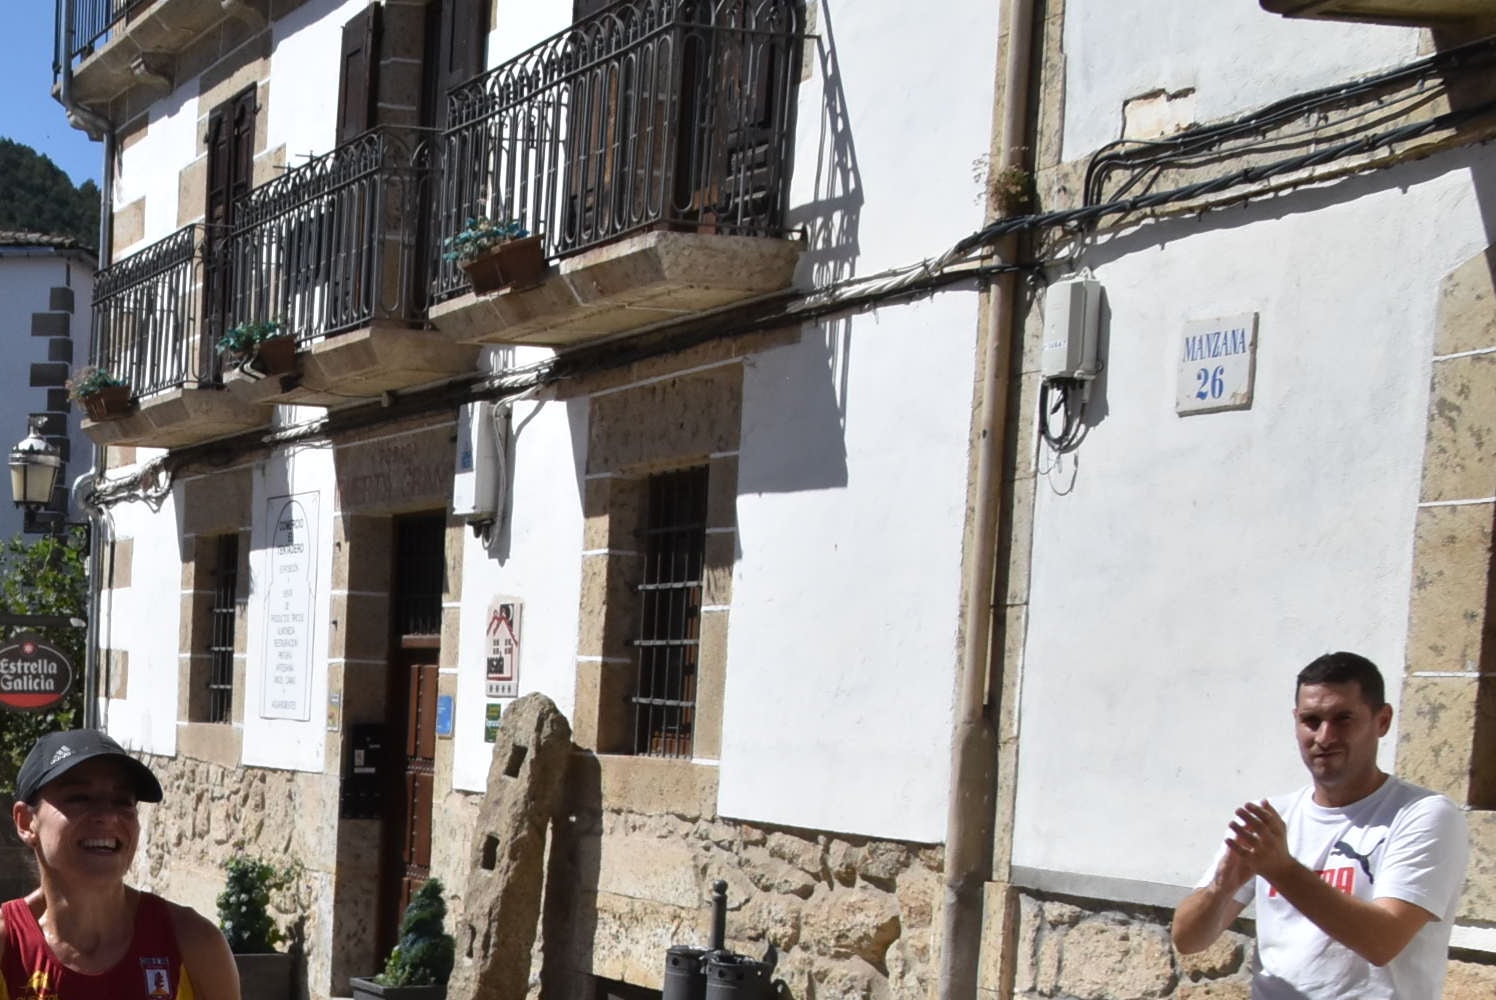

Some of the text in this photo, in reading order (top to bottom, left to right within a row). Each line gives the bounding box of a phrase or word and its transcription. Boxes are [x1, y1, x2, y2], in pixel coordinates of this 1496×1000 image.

[1183, 327, 1247, 362] MANZANA
[1195, 365, 1225, 400] 26
[0, 658, 57, 674] Estrella
[0, 675, 55, 690] Galicia
